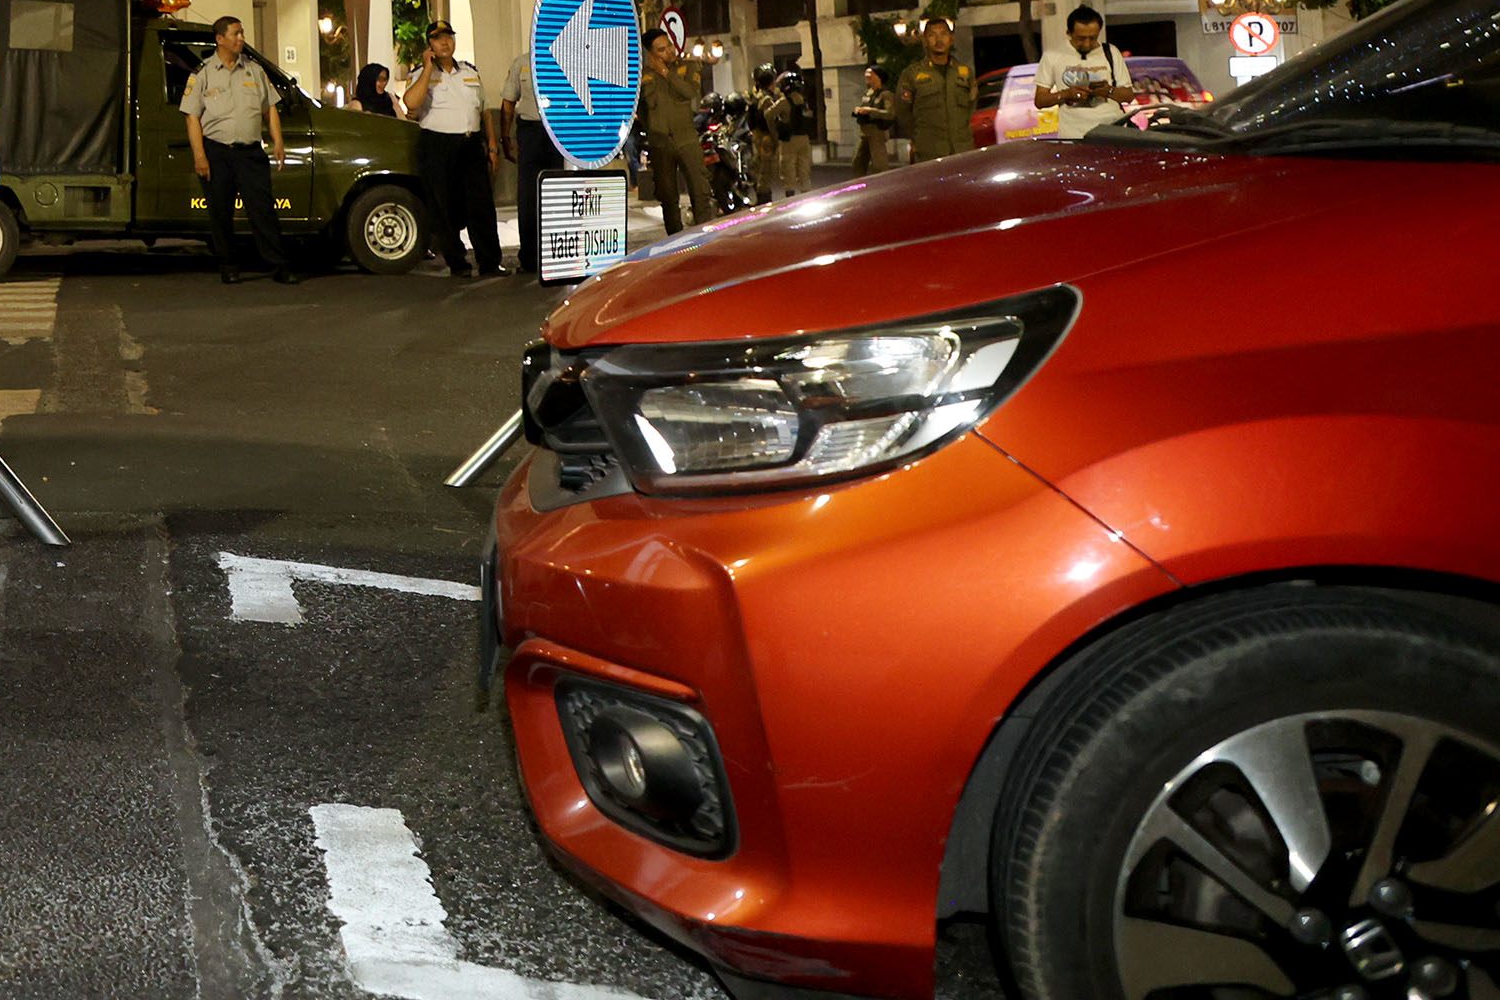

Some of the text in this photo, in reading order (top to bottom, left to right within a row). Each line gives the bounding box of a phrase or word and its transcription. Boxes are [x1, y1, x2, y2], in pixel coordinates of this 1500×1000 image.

[571, 187, 603, 217] Parkir
[550, 228, 619, 259] Valet DISHUB
